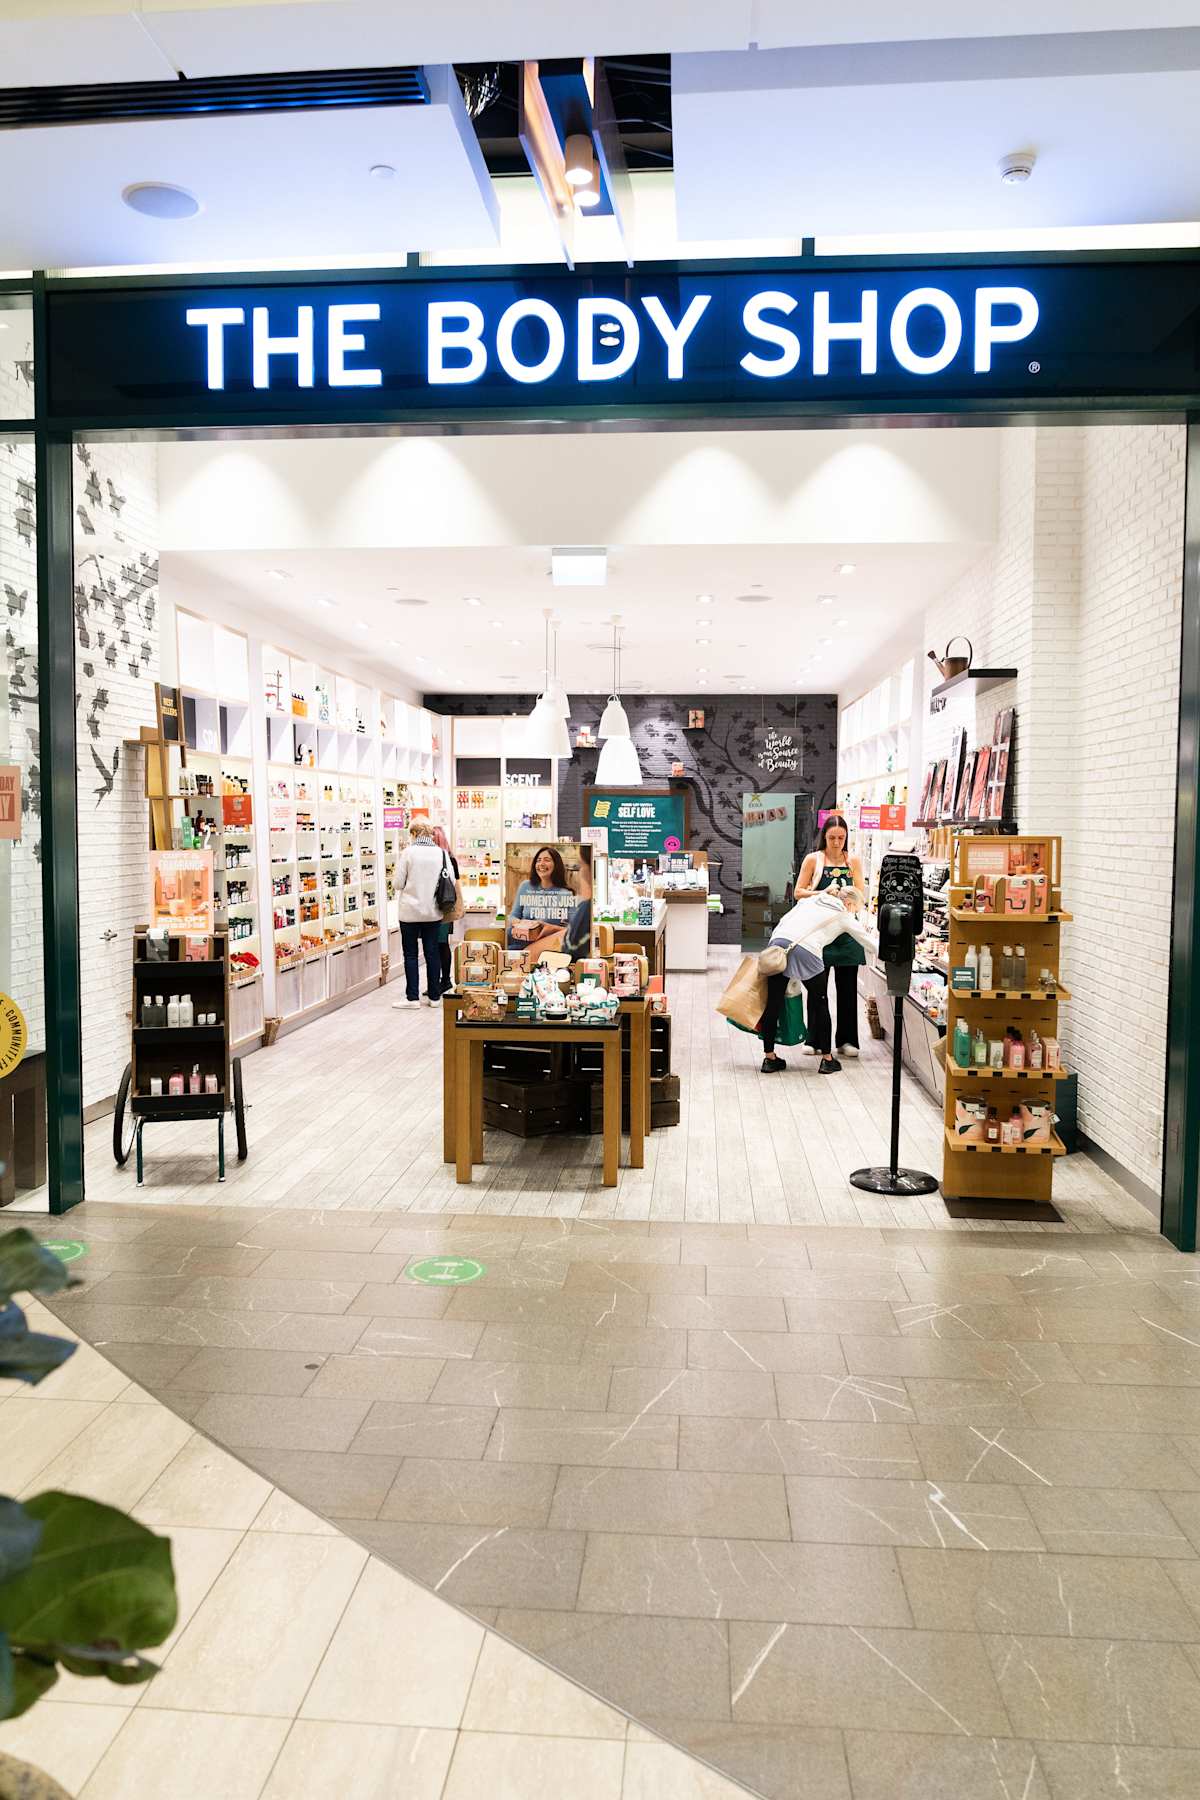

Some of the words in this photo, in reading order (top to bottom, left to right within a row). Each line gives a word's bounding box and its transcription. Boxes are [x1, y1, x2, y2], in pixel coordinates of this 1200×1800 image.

[187, 304, 382, 389] THE
[427, 296, 711, 385] BODY
[741, 287, 1039, 377] SHOP
[764, 735, 793, 750] World
[772, 746, 799, 760] Source
[765, 758, 799, 772] Beauty
[505, 773, 542, 787] SCENT
[617, 806, 635, 818] SELF
[636, 806, 656, 818] LOVE
[519, 895, 557, 908] MOMENTS
[558, 895, 579, 909] JUST
[530, 908, 546, 920] FOR
[547, 908, 568, 921] THEM
